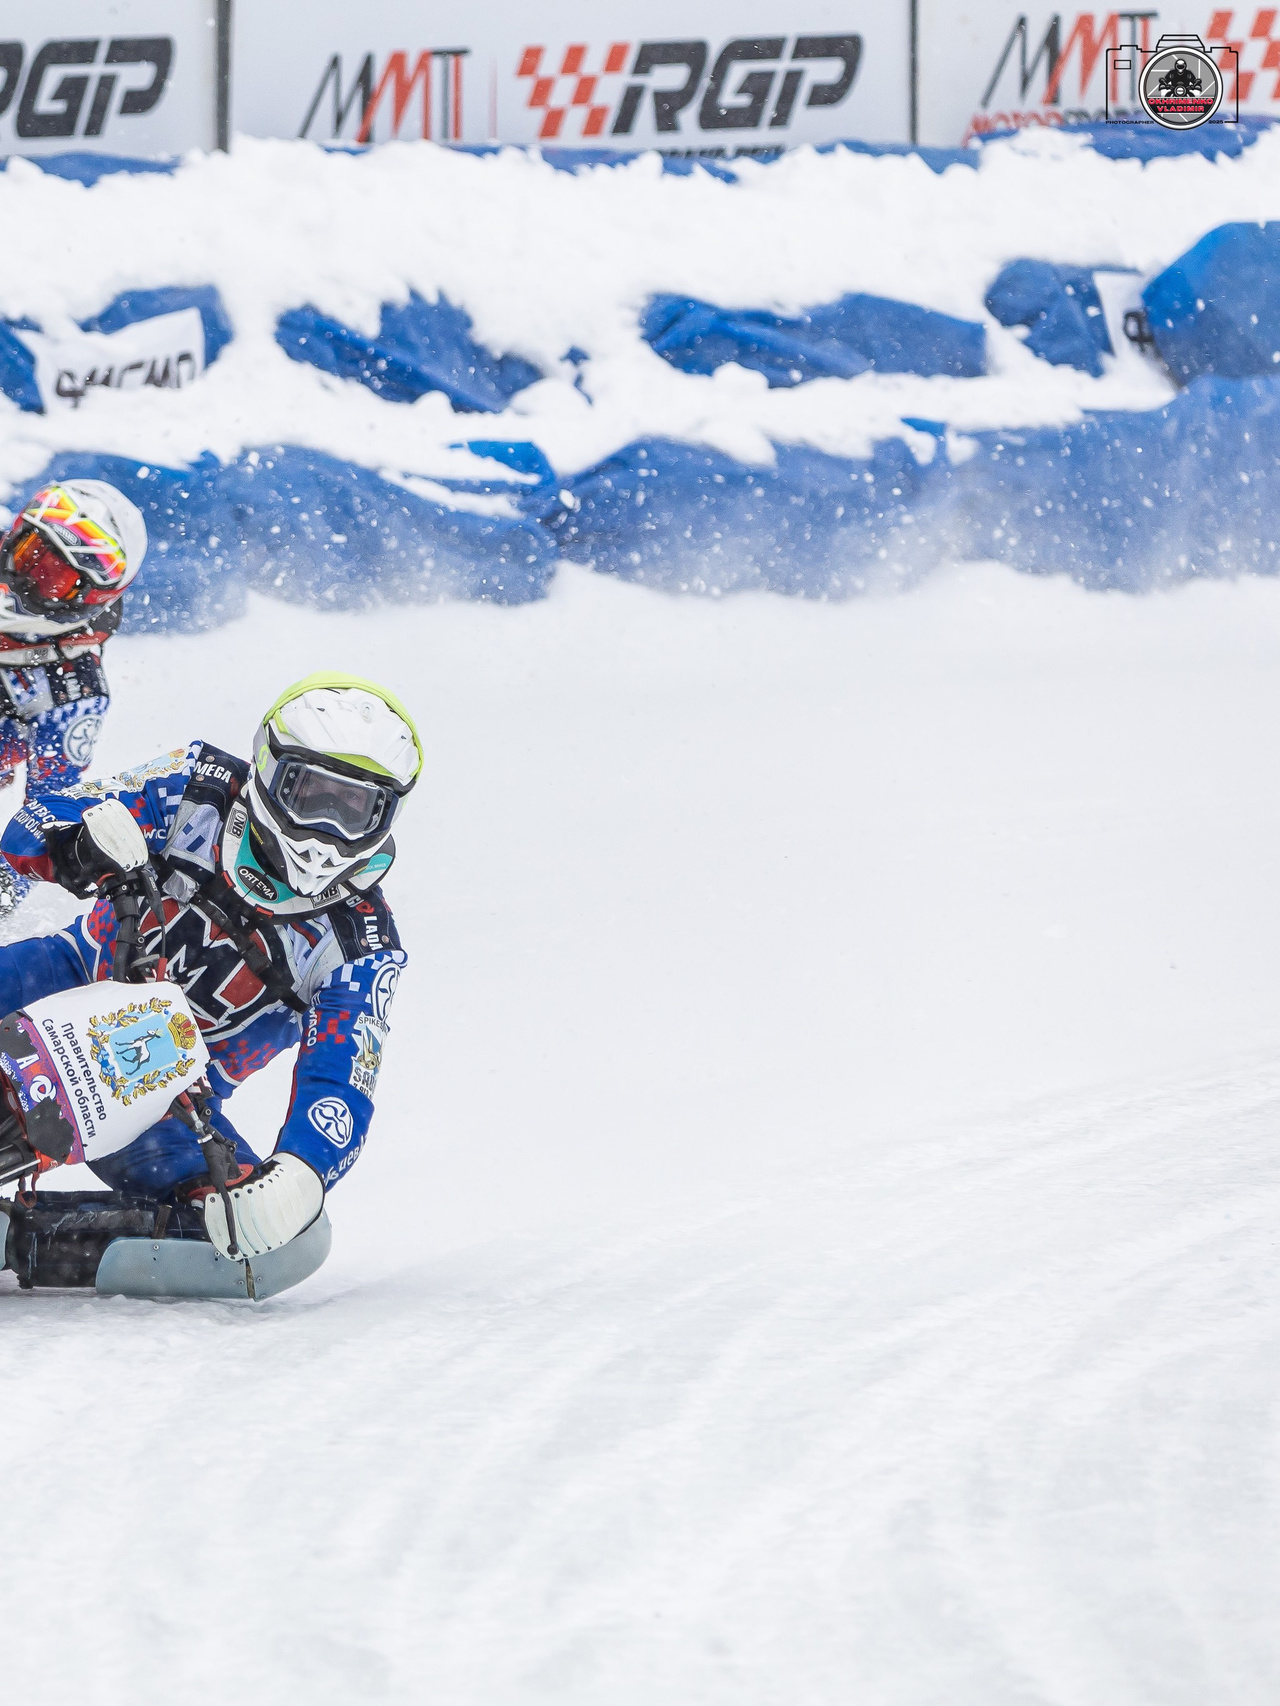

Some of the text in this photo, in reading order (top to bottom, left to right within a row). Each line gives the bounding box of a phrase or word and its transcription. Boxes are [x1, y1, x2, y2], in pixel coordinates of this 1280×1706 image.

[612, 32, 863, 135] RGP
[193, 761, 233, 784] MEGA
[239, 868, 276, 898] ORTEMA
[363, 915, 384, 951] LADA
[42, 1018, 97, 1139] Самарской области
[61, 1021, 107, 1121] Правительство
